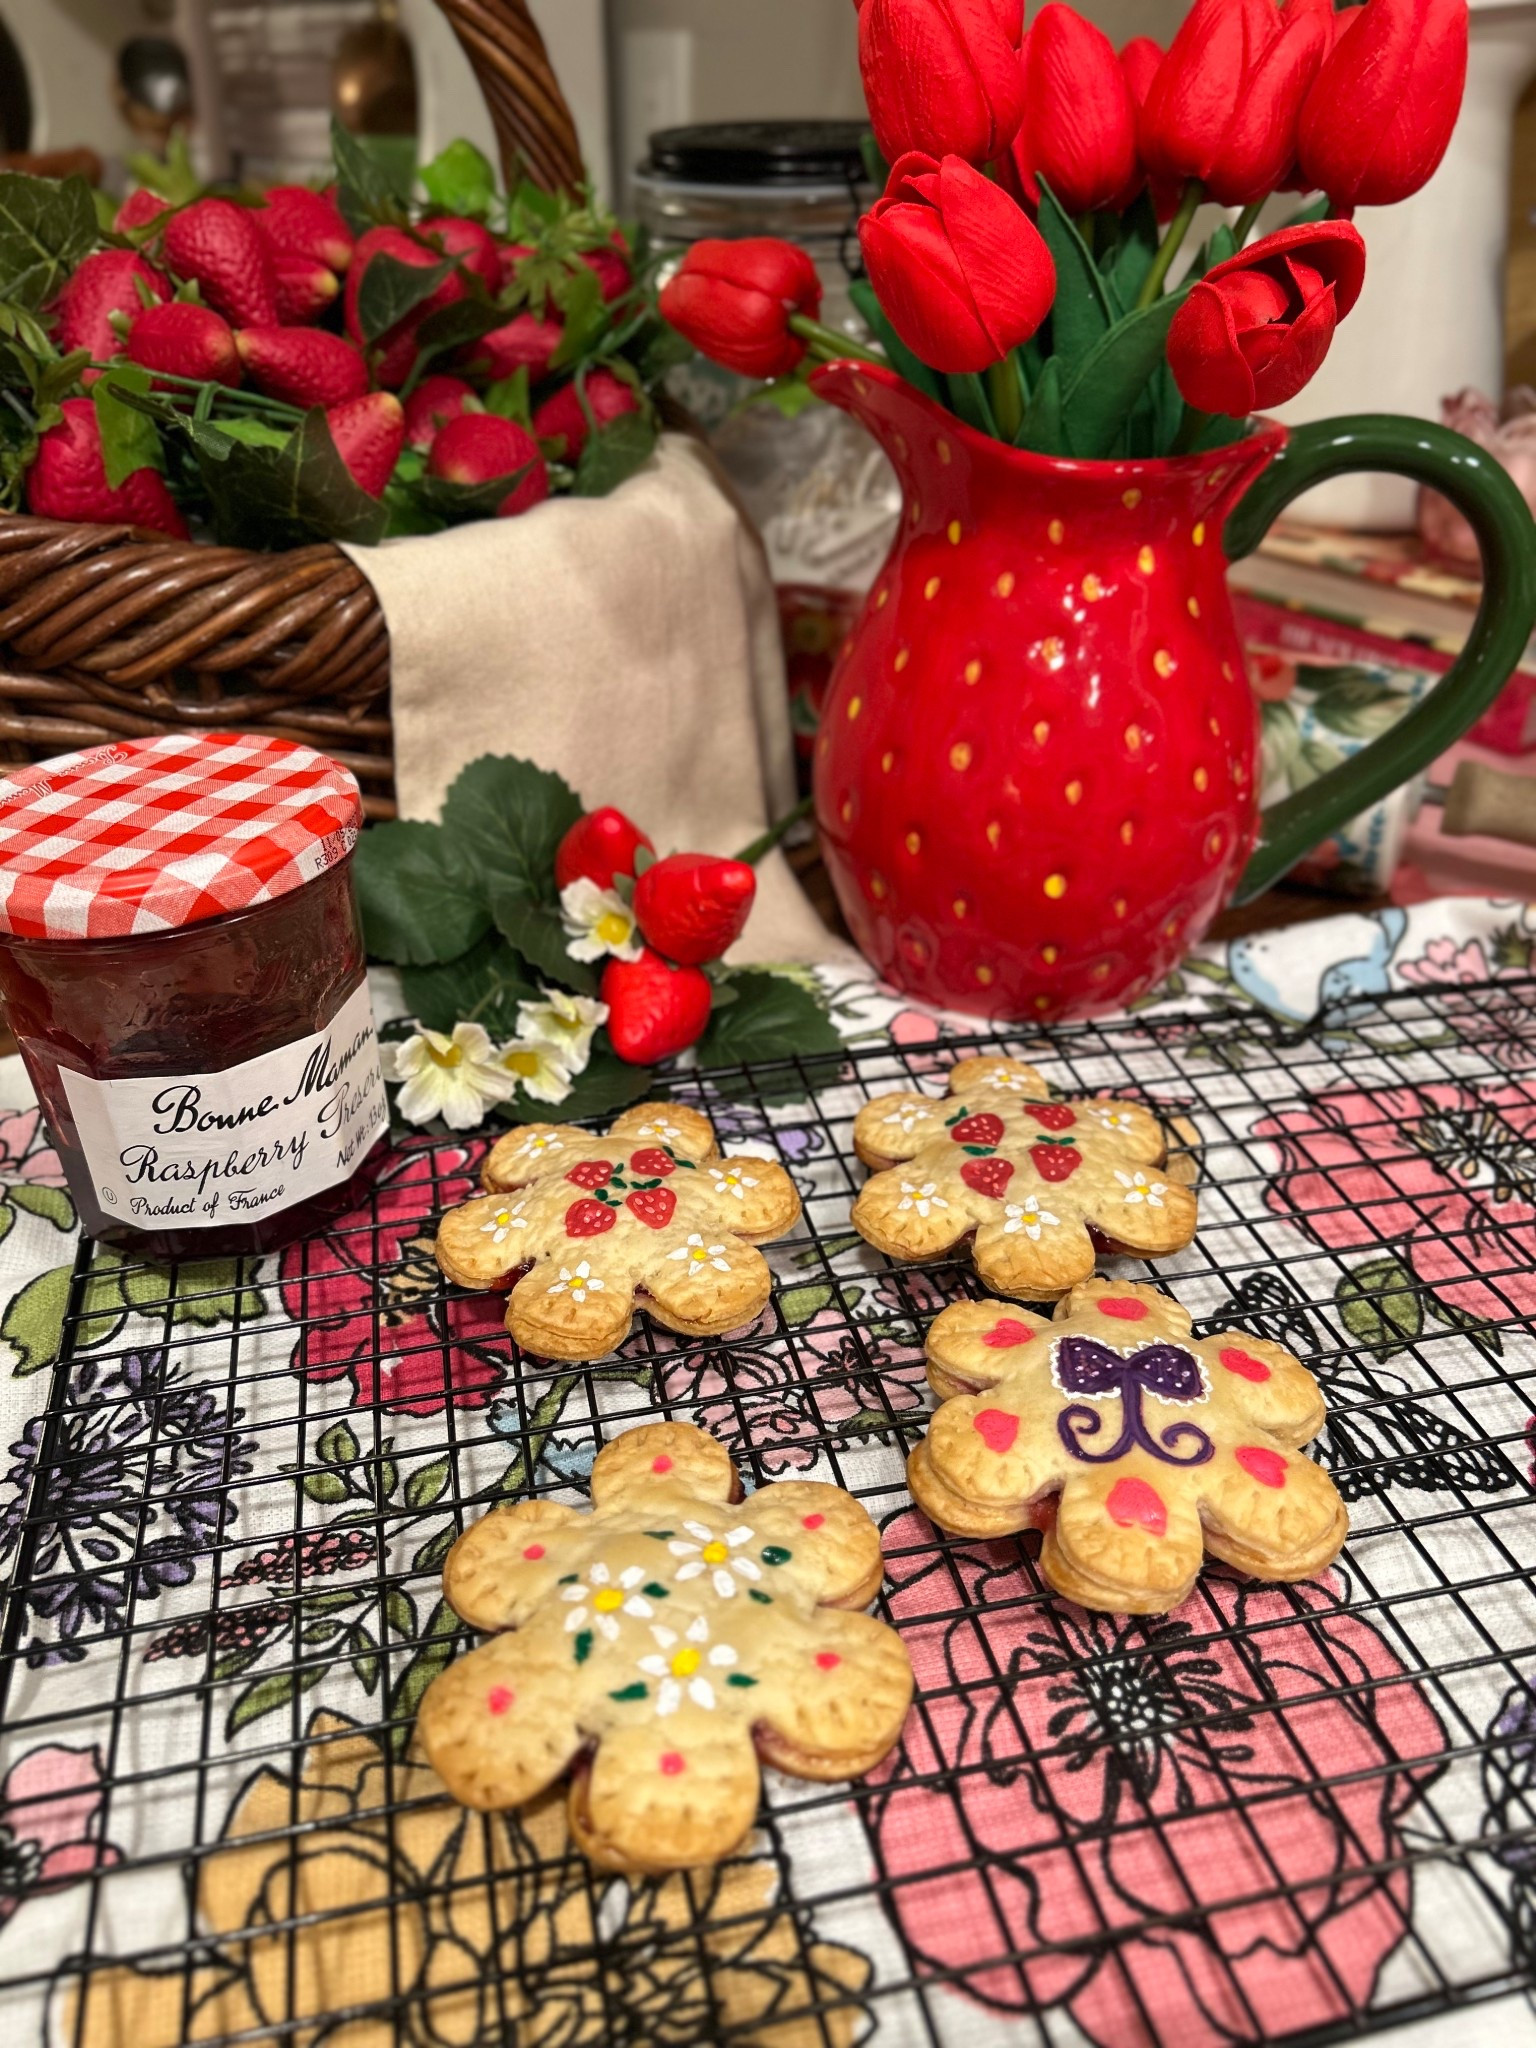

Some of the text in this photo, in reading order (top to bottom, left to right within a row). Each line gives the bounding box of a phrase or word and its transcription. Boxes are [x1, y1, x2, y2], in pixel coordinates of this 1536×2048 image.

[315, 847, 338, 870] R309
[152, 1026, 374, 1134] Bonne Maman
[120, 1131, 310, 1195] Raspberry
[337, 1138, 355, 1168] Net
[130, 1184, 286, 1219] Product of France
